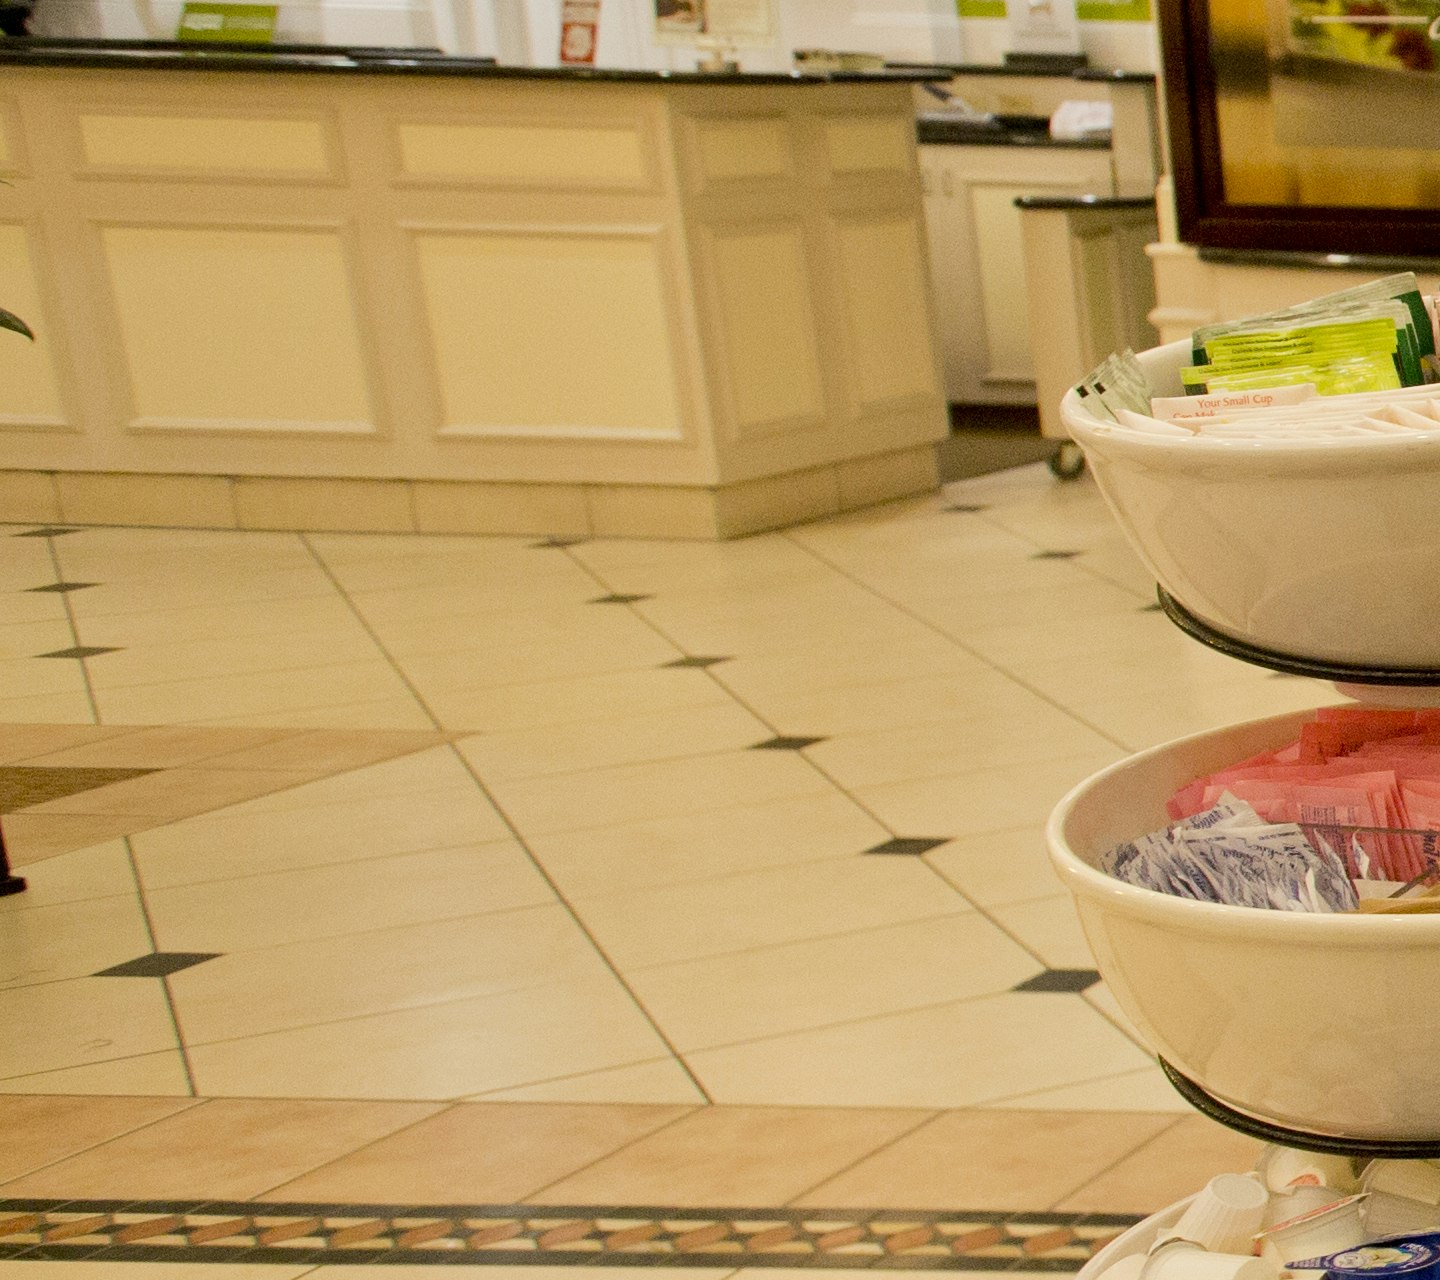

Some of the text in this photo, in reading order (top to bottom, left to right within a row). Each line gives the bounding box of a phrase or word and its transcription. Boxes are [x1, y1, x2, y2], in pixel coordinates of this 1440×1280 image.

[1196, 394, 1274, 410] Your Small Cup
